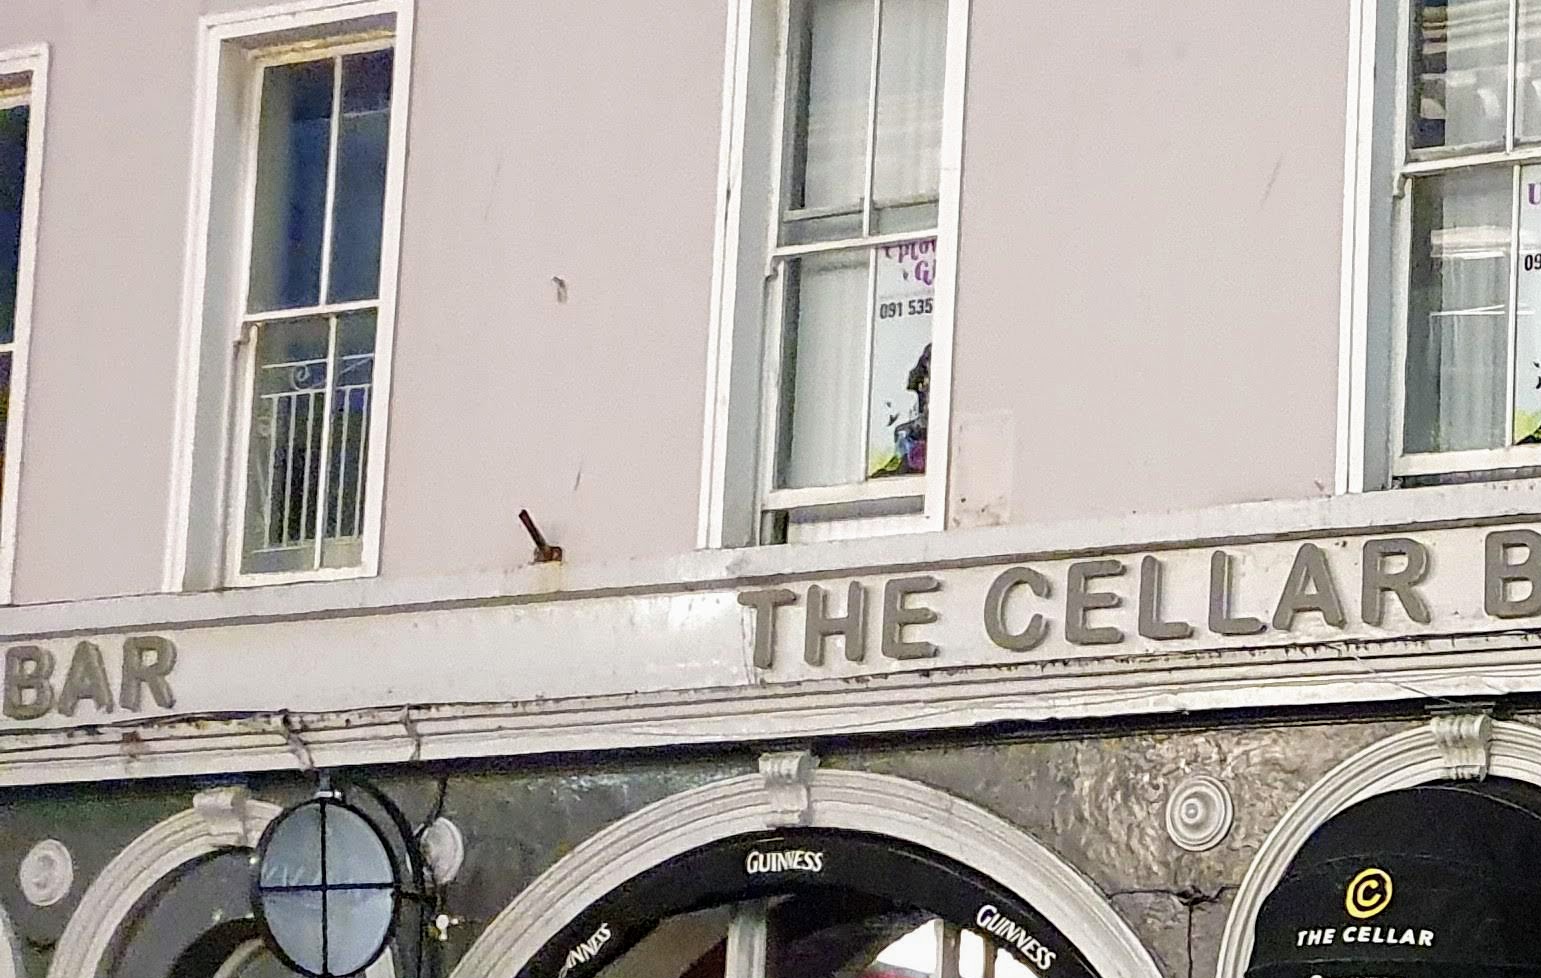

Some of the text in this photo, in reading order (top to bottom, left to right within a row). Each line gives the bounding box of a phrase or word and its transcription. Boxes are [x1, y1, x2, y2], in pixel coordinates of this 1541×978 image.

[879, 297, 934, 320] 091 535
[736, 574, 943, 671] THE
[983, 536, 1434, 653] CELLAR
[2, 635, 178, 721] BAR
[976, 904, 1057, 970] GUINNESS
[1297, 926, 1435, 947] THE CELLAR
